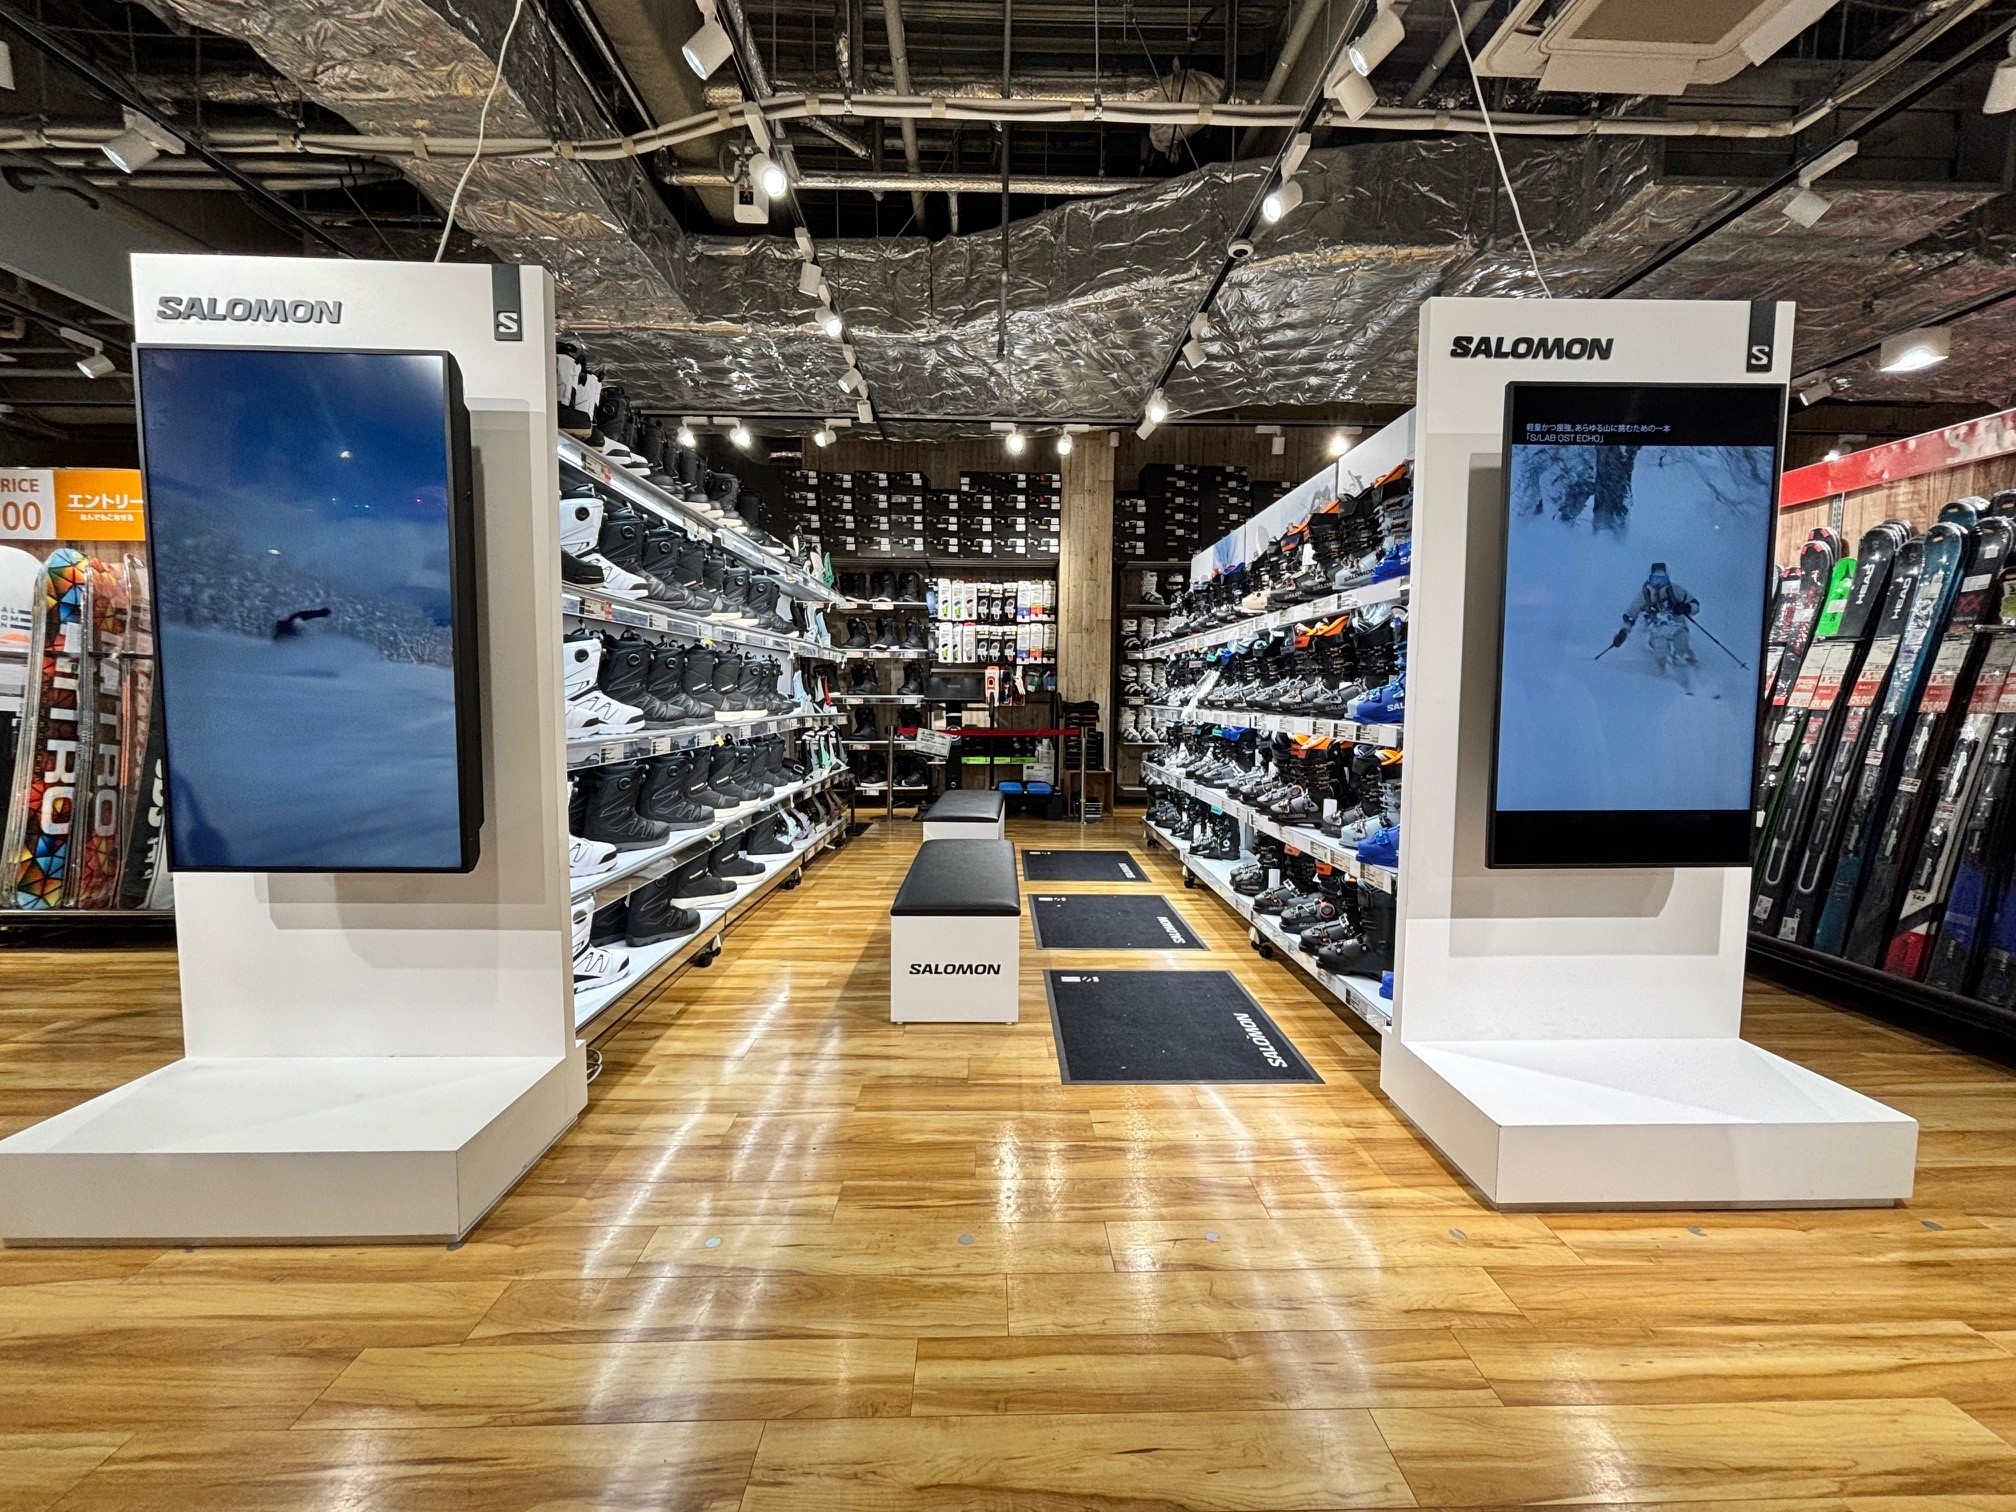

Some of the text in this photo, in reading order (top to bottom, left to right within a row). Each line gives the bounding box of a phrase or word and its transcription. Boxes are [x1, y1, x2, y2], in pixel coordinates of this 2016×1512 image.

[157, 296, 342, 324] SALOMON
[496, 310, 518, 333] S
[1450, 336, 1614, 360] SALOMON
[1750, 344, 1770, 366] S
[1557, 433, 1575, 443] QST
[0, 478, 40, 493] RICE
[68, 493, 144, 510] エントリー
[1855, 563, 1876, 605] HEAD
[1890, 577, 1913, 620] HEAD
[908, 963, 1002, 975] SALOMON
[1232, 1012, 1289, 1068] SALOMON
